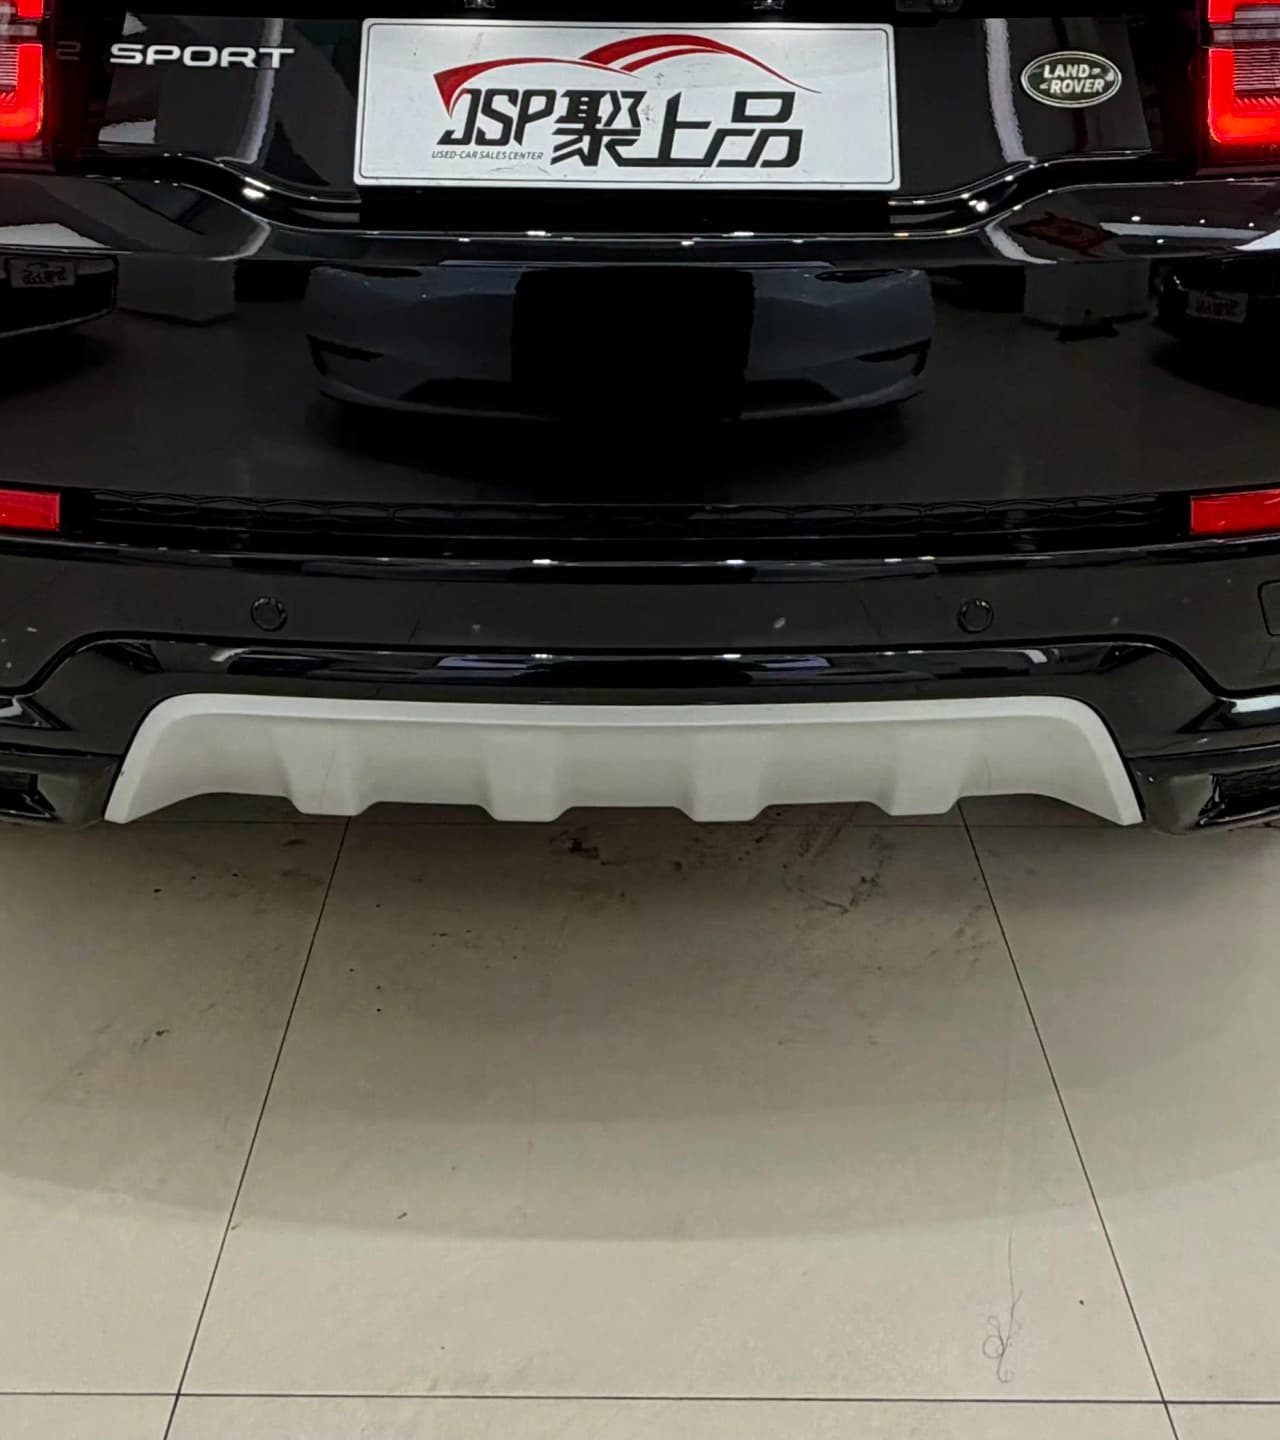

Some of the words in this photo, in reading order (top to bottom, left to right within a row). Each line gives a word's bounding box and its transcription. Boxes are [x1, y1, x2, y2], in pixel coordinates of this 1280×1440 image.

[110, 43, 295, 70] SPORT
[1043, 63, 1090, 78] LAND
[1049, 78, 1105, 94] ROVER
[436, 88, 556, 147] JSP
[550, 90, 804, 169] 聚上品
[431, 150, 478, 160] USED-CAR
[479, 150, 507, 160] SALES
[508, 151, 545, 161] CENTER
